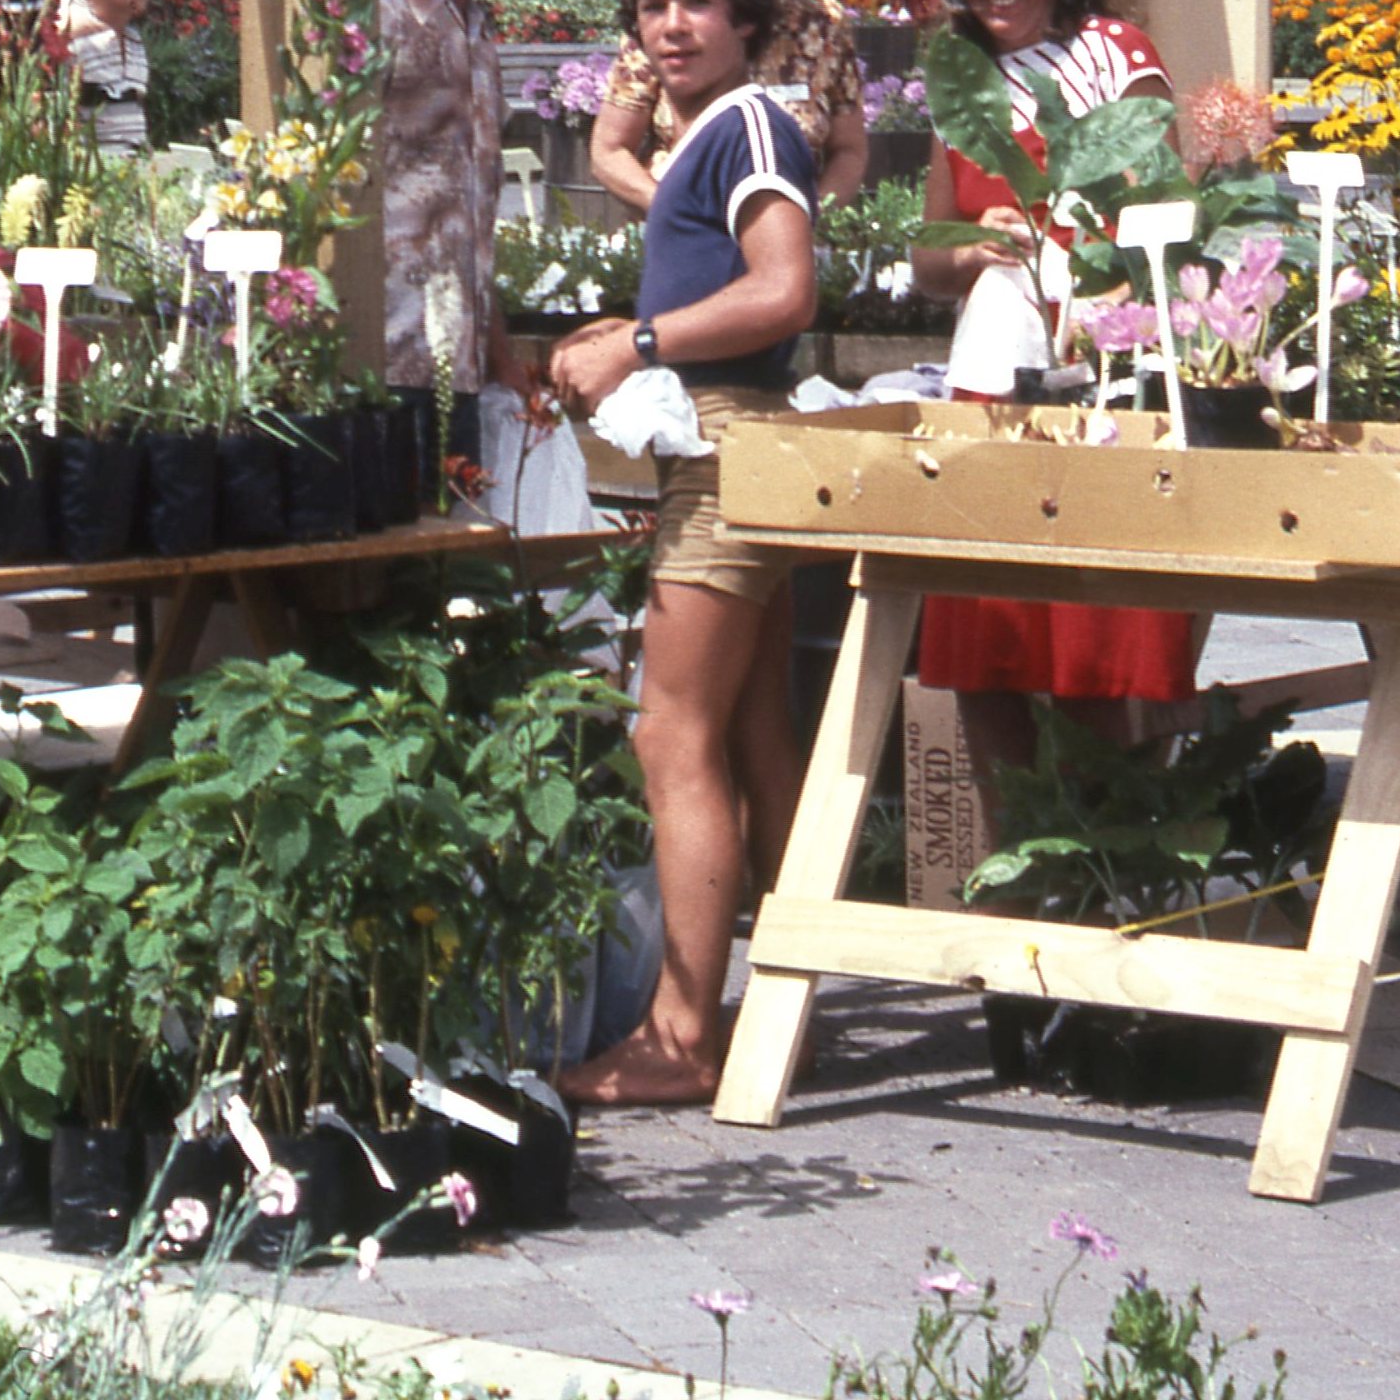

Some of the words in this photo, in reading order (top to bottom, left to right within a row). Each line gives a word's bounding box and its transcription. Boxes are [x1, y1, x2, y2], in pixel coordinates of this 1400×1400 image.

[907, 721, 922, 833] ZEALAND
[924, 747, 953, 869] SMOKED
[909, 851, 923, 901] NEW
